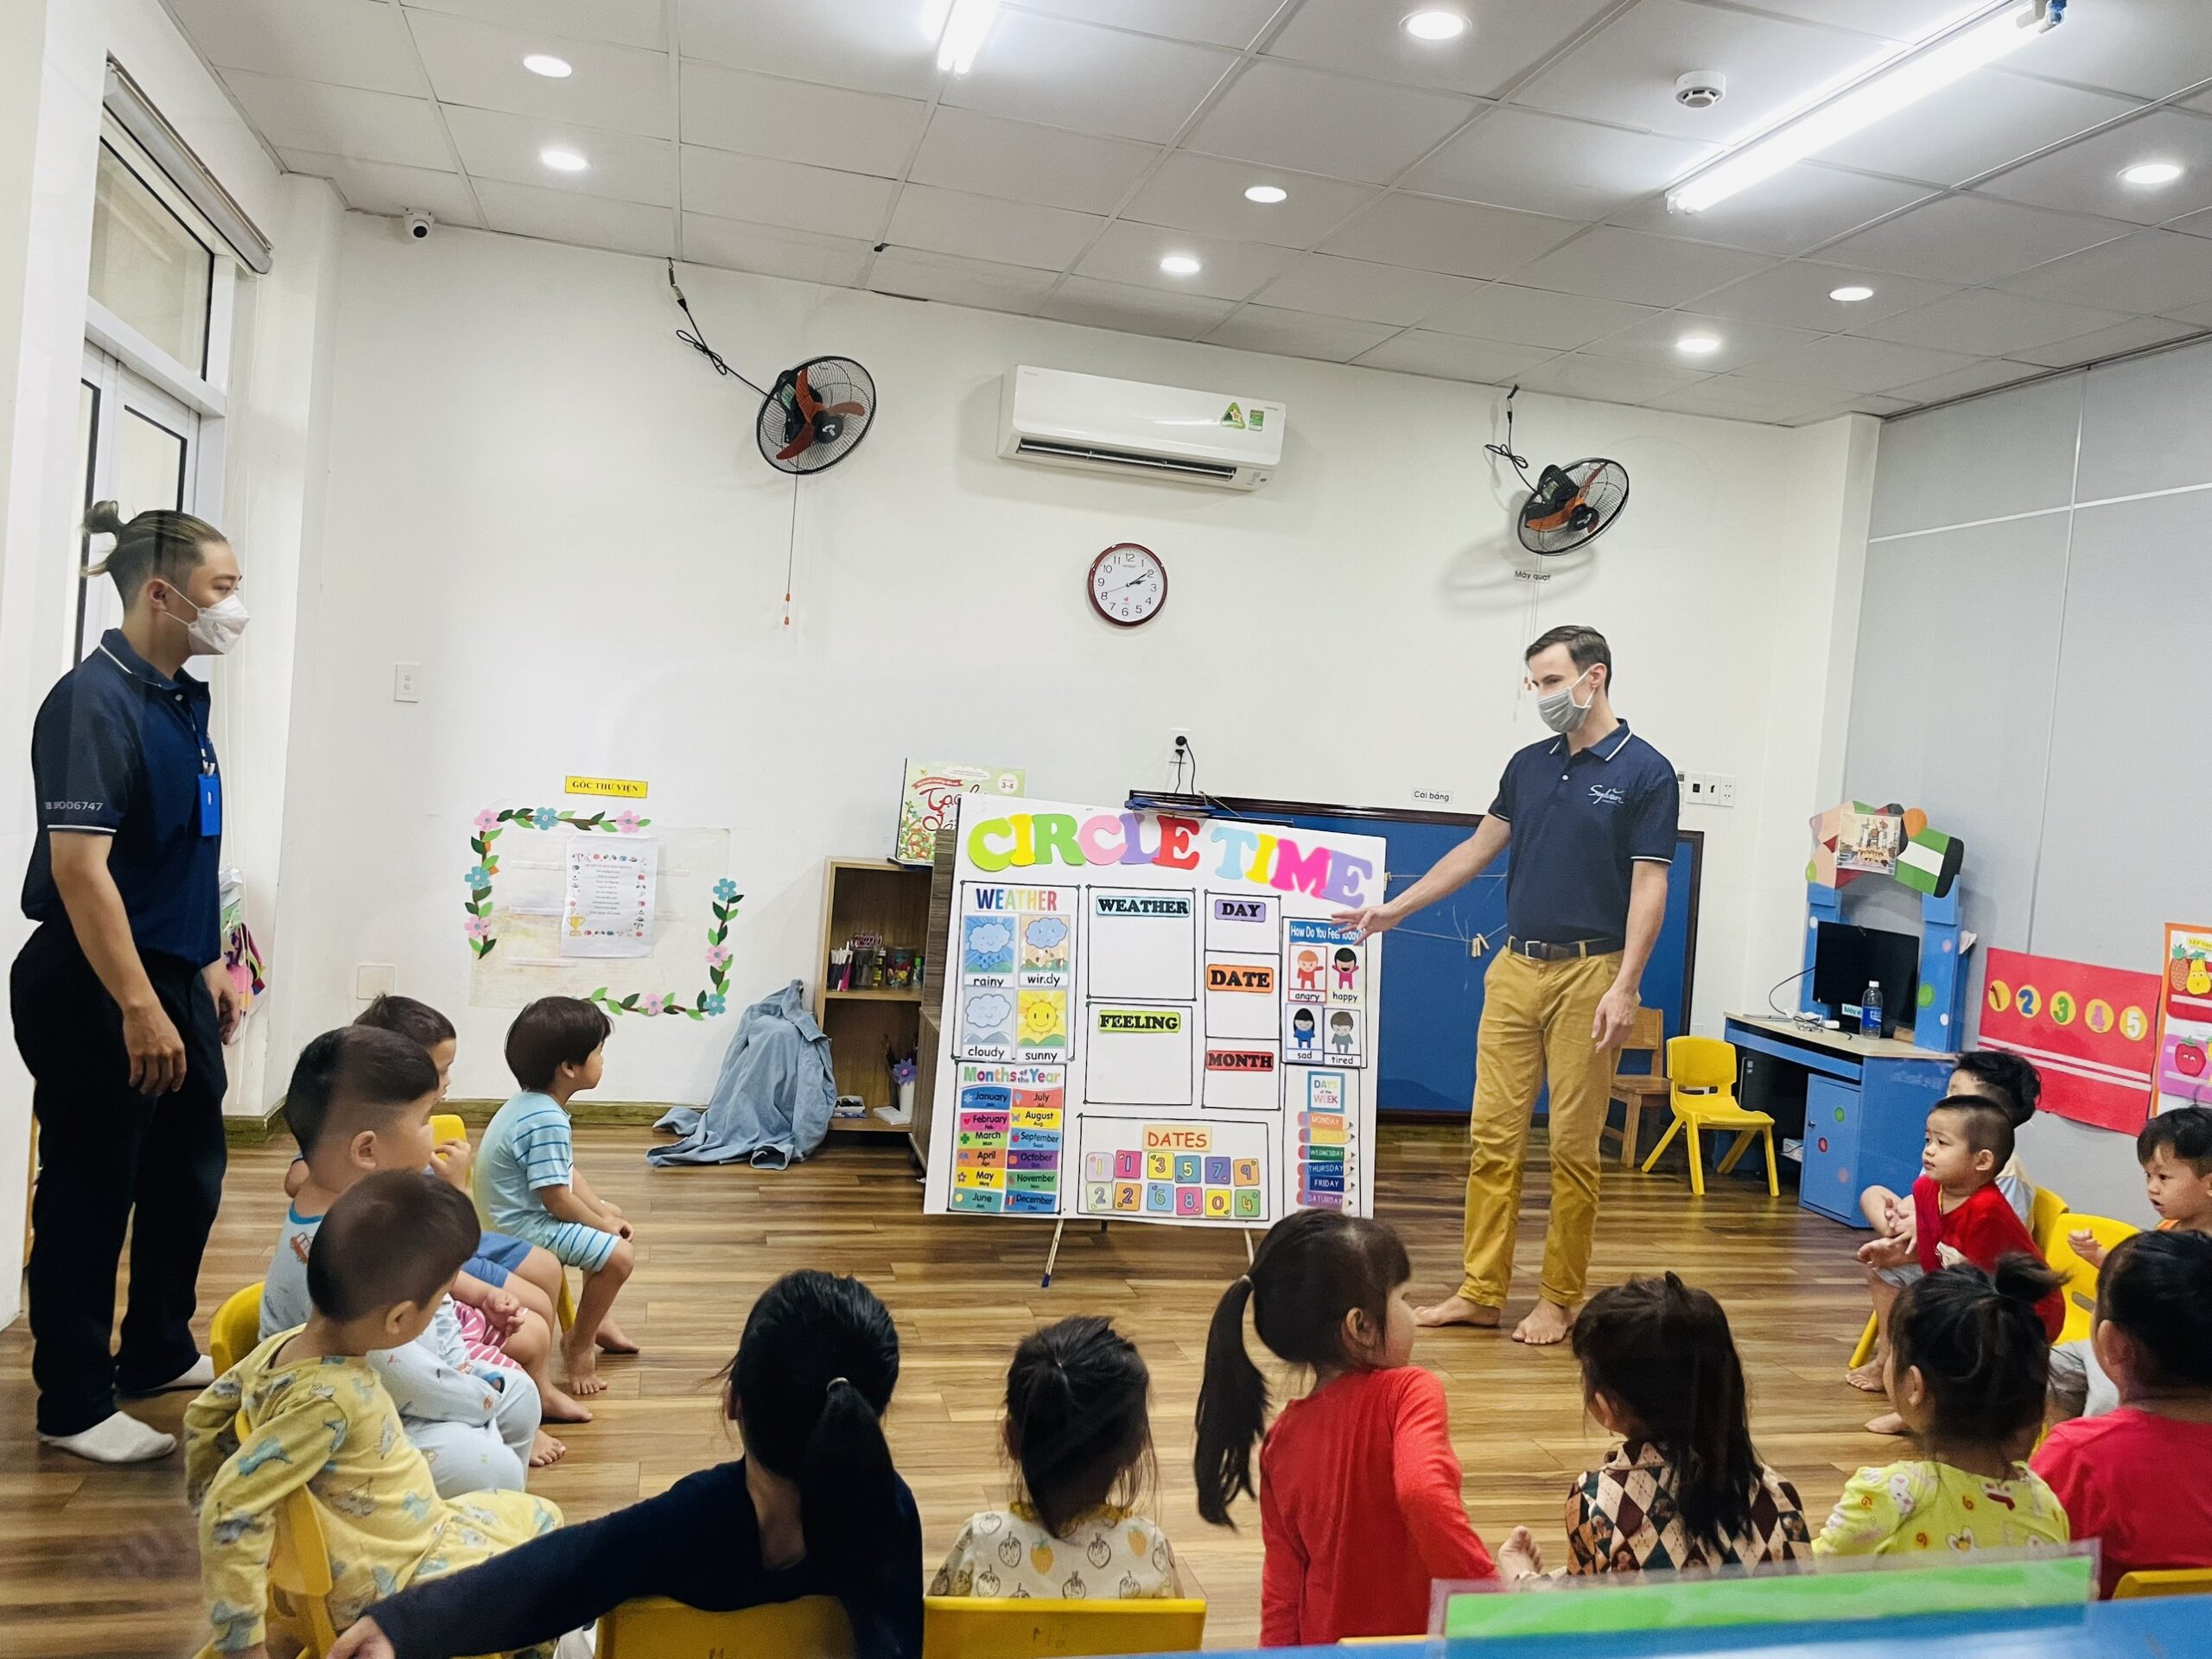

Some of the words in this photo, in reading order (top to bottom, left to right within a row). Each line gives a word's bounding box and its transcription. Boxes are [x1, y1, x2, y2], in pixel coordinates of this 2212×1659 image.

[1114, 556, 1121, 564] 11
[1126, 553, 1135, 562] 12
[1147, 569, 1154, 578] 2
[1098, 578, 1105, 587] 9
[1150, 583, 1157, 592] 3
[1101, 592, 1108, 601] 8
[1122, 607, 1128, 616] 6
[572, 779, 593, 789] GÓC
[968, 813, 1200, 872] CIRCLE
[1211, 826, 1373, 908] TIME
[976, 888, 1058, 911] WEATHER
[1098, 899, 1189, 914] WEATHER
[1222, 903, 1261, 918] DAY
[1290, 925, 1305, 938] How
[1306, 926, 1313, 938] Do
[1316, 926, 1327, 938] You
[973, 976, 1004, 988] rainy
[1027, 974, 1060, 988] windy
[1211, 969, 1270, 988] DATE
[1295, 993, 1320, 1002] angry
[1332, 991, 1358, 1003] happy
[2018, 988, 2034, 1015] 2
[2053, 995, 2069, 1023] 3
[2091, 1005, 2105, 1031] 4
[2126, 1010, 2141, 1038] 5
[1100, 1014, 1179, 1030] FEELING
[968, 1046, 1005, 1059] cloudy
[1025, 1051, 1058, 1062] sunny
[1297, 1051, 1313, 1059] sad
[1206, 1052, 1273, 1068] MONTH
[1332, 1056, 1354, 1065] tired
[963, 1066, 1017, 1083] Months
[1029, 1068, 1060, 1083] Year
[1313, 1079, 1338, 1089] DAYS
[975, 1092, 1008, 1103] January
[1033, 1092, 1050, 1102] July
[1313, 1095, 1338, 1104] WEEK
[973, 1115, 1007, 1125] February
[1026, 1110, 1053, 1121] August
[1311, 1116, 1339, 1125] MONDAY
[1020, 1132, 1058, 1143] September
[1147, 1131, 1207, 1147] DATES
[977, 1150, 996, 1161] April
[1020, 1153, 1052, 1161] October
[1096, 1158, 1103, 1176] 1
[1124, 1155, 1131, 1172] 1
[1155, 1157, 1166, 1173] 3
[1182, 1160, 1193, 1177] 5
[1212, 1163, 1224, 1179] 7
[1240, 1164, 1252, 1180] 9
[976, 1171, 995, 1181] May
[1017, 1174, 1055, 1183] November
[1314, 1179, 1339, 1187] FRIDAY
[972, 1192, 993, 1203] June
[1016, 1194, 1053, 1205] December
[1094, 1187, 1106, 1205] 2
[1122, 1187, 1134, 1204] 2
[1154, 1189, 1166, 1205] 6
[1184, 1192, 1195, 1209] 8
[1211, 1196, 1224, 1211] 0
[1242, 1196, 1253, 1211] 4
[1307, 1195, 1342, 1205] SATURDAY
